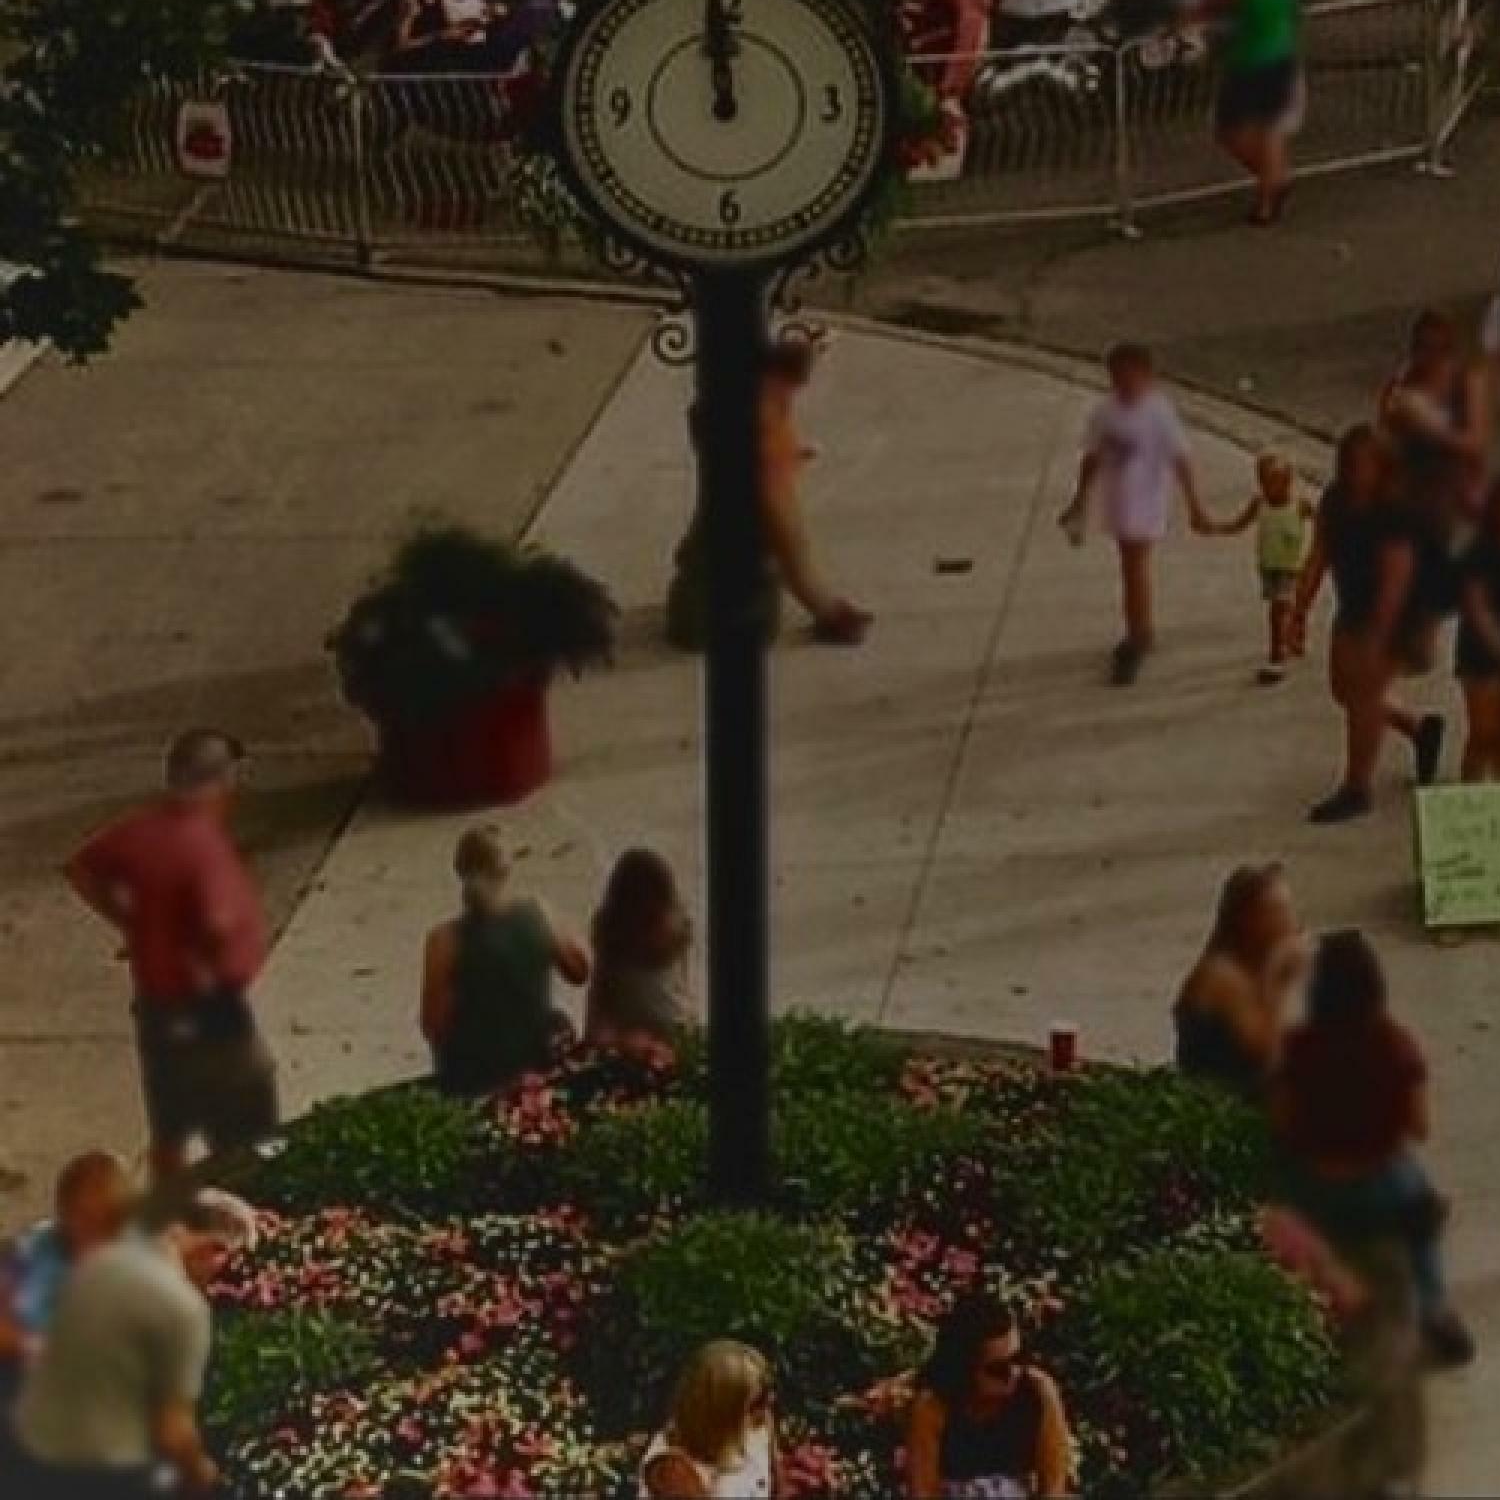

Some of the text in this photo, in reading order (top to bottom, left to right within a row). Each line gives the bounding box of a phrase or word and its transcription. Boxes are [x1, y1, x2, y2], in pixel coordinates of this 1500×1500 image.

[611, 88, 631, 127] 9
[820, 85, 841, 123] 3
[719, 191, 740, 223] 6
